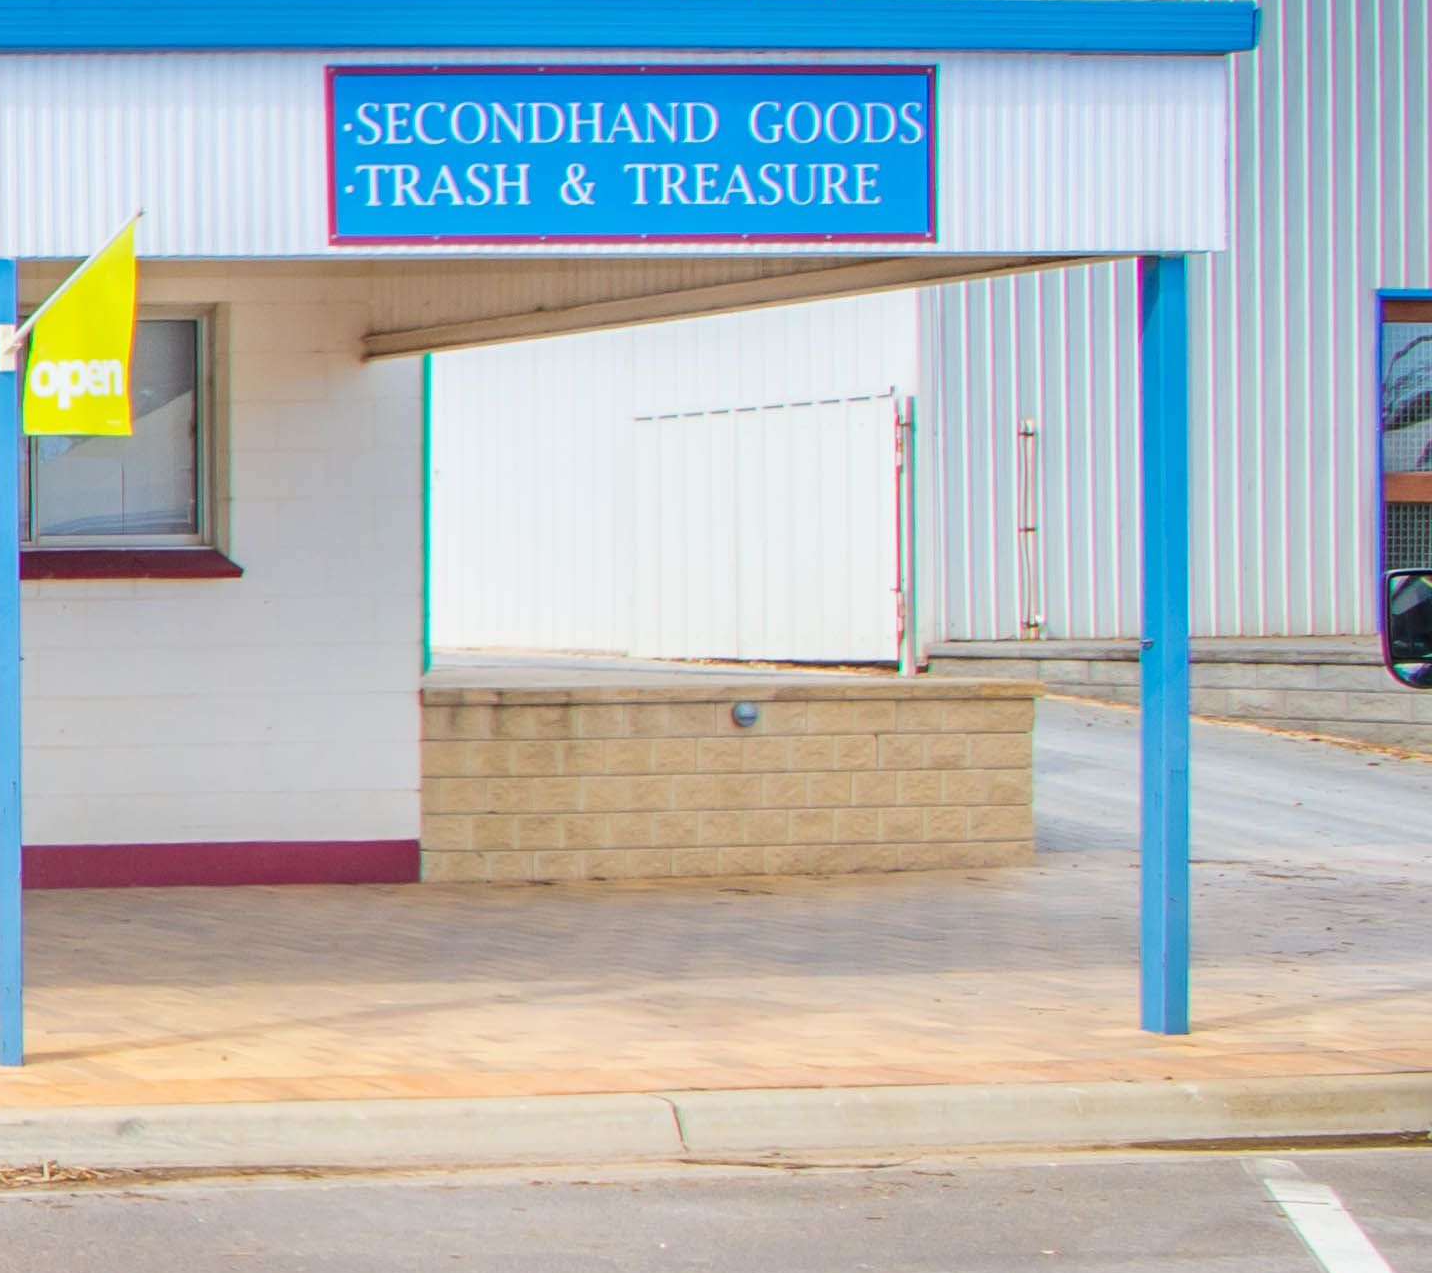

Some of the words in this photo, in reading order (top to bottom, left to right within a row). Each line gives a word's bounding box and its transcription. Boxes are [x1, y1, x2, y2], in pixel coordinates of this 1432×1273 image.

[747, 100, 925, 145] GOODS
[560, 163, 595, 205] &
[623, 163, 882, 206] TREASURE
[30, 358, 124, 410] open
